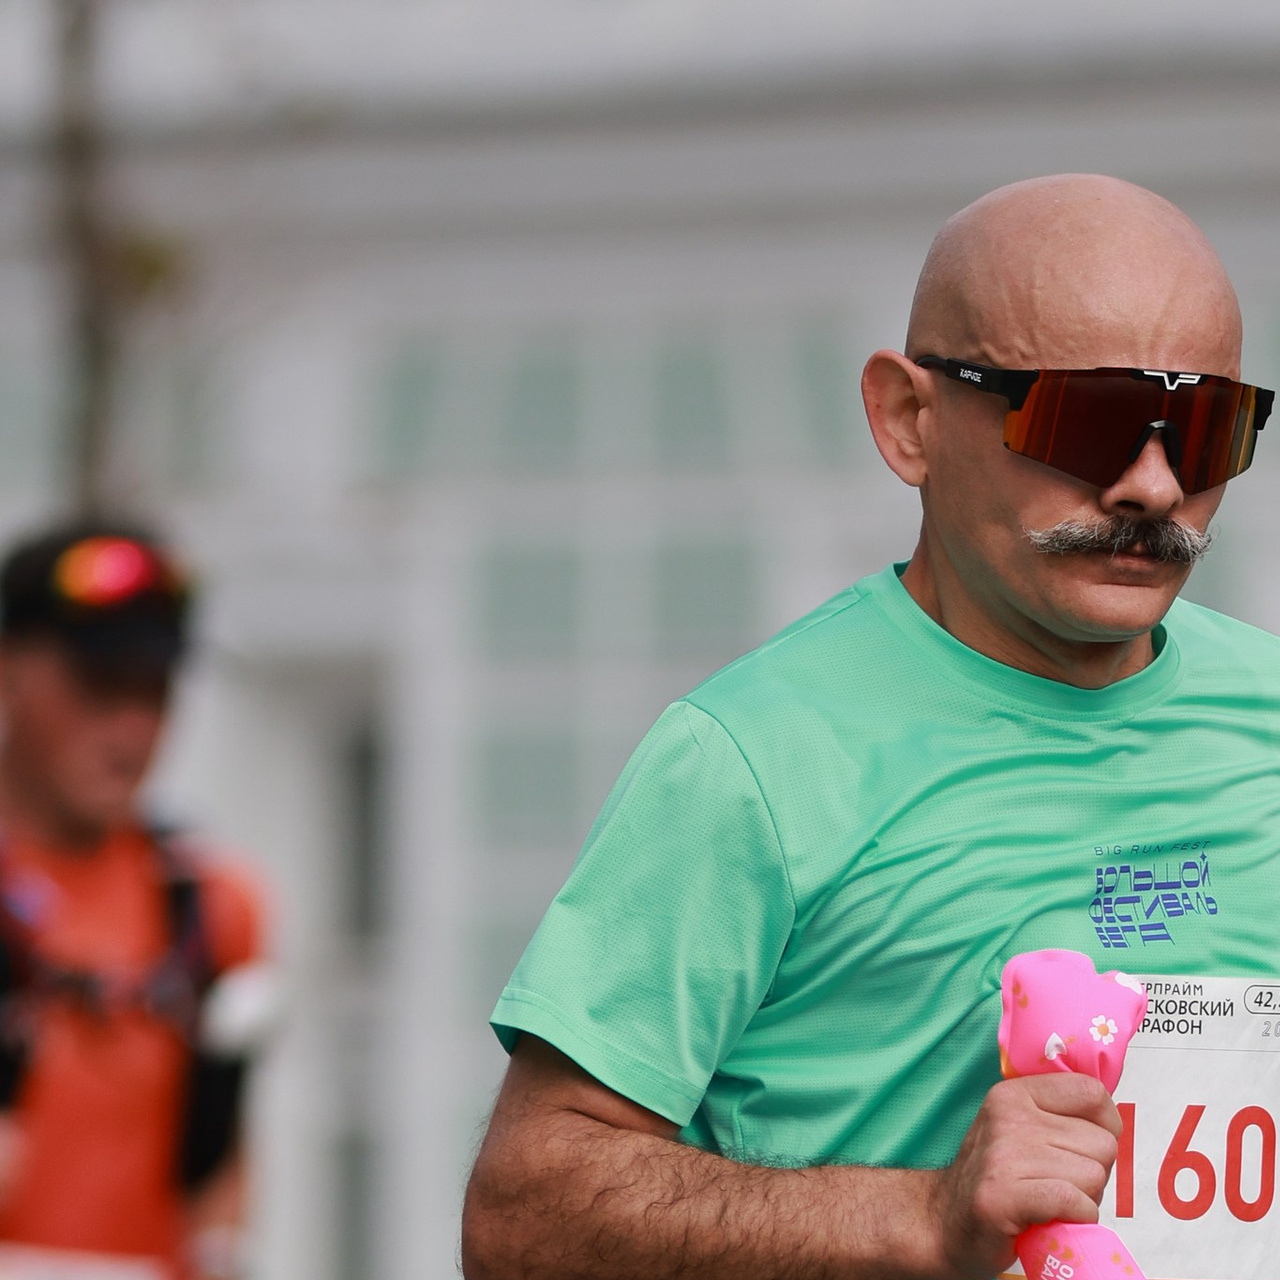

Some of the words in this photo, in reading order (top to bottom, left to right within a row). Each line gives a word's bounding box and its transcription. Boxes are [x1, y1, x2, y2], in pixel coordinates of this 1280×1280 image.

[1094, 845, 1122, 856] BIG
[1130, 844, 1164, 855] RUN
[1170, 841, 1211, 852] FEST
[1088, 891, 1218, 924] ФЕСТИВАЛЬ
[1095, 922, 1176, 949] БЕГА
[1141, 981, 1204, 996] РПРАЙМ
[1146, 998, 1234, 1017] СКОВСКИЙ
[1137, 1018, 1203, 1035] РАФОН
